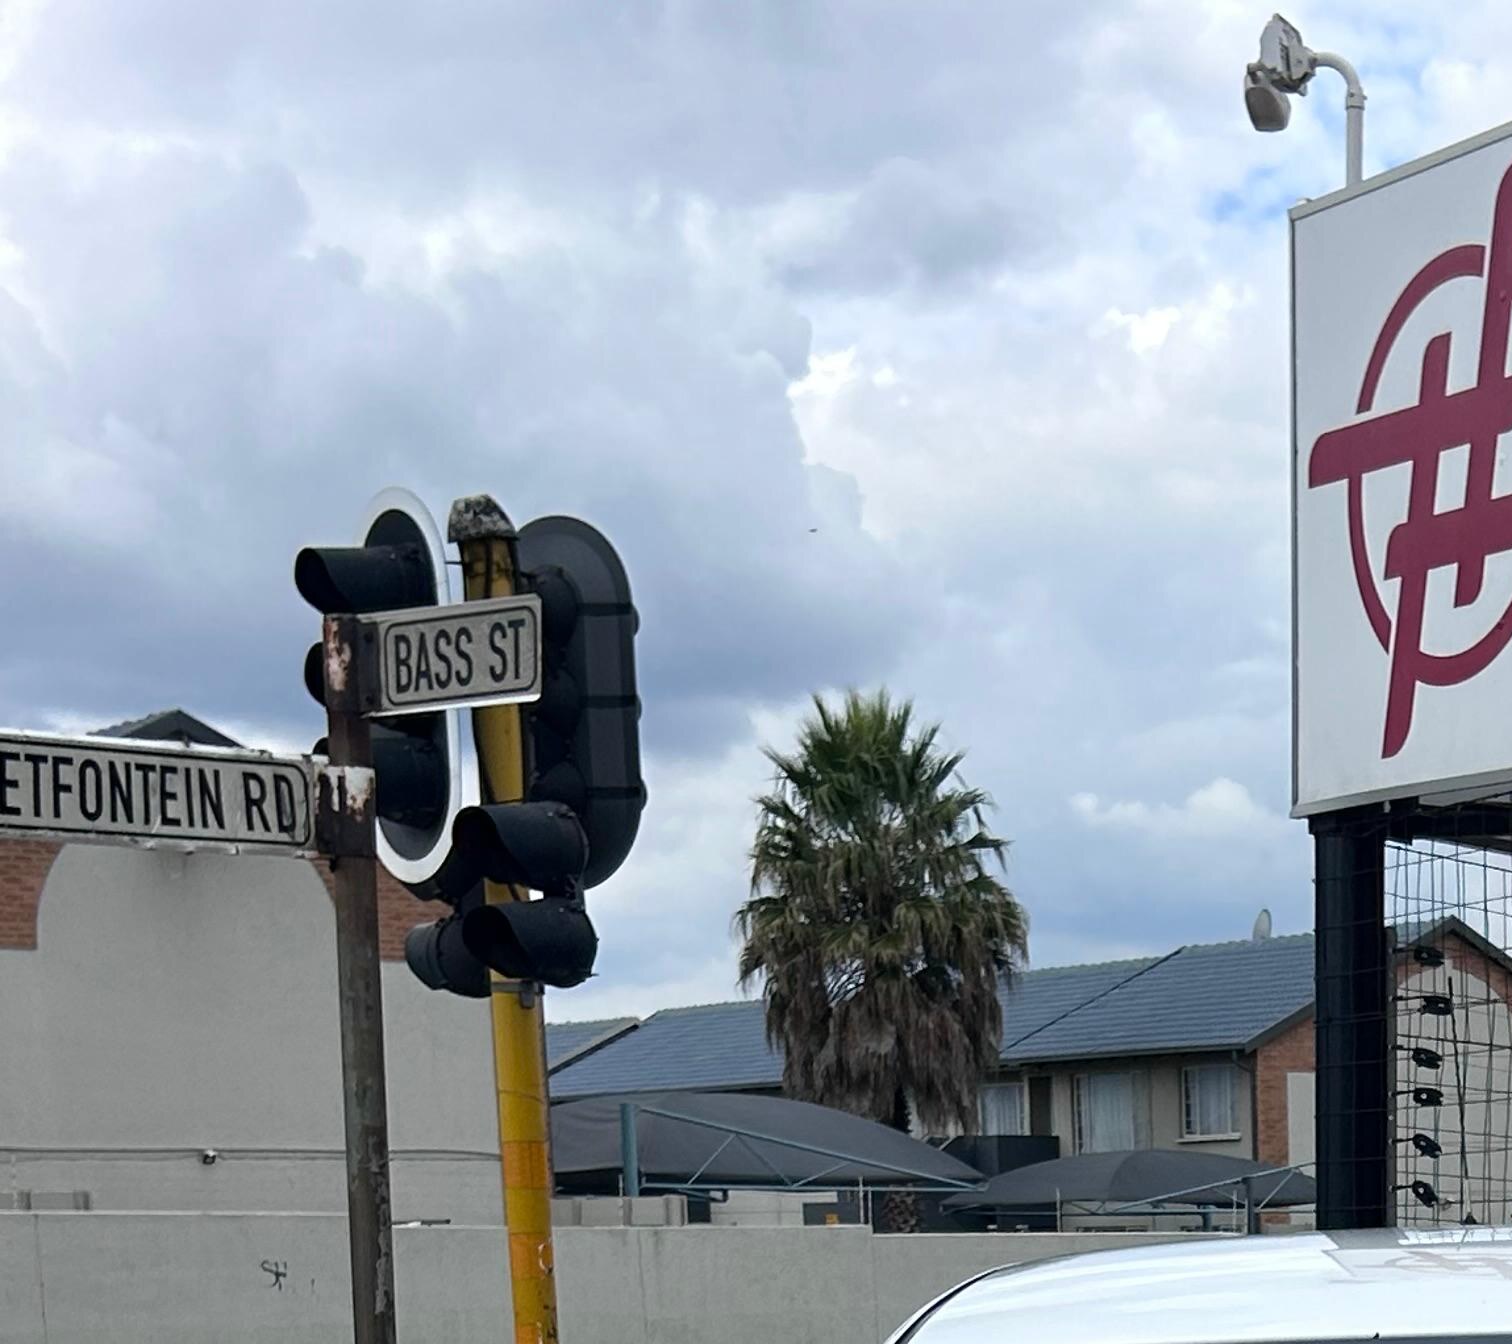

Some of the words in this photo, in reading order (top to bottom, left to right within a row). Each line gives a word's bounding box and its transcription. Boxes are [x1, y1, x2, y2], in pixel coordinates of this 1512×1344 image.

[394, 626, 474, 695] BASS
[489, 618, 526, 684] ST
[0, 752, 226, 831] ETFONTEIN
[242, 771, 298, 834] RD
